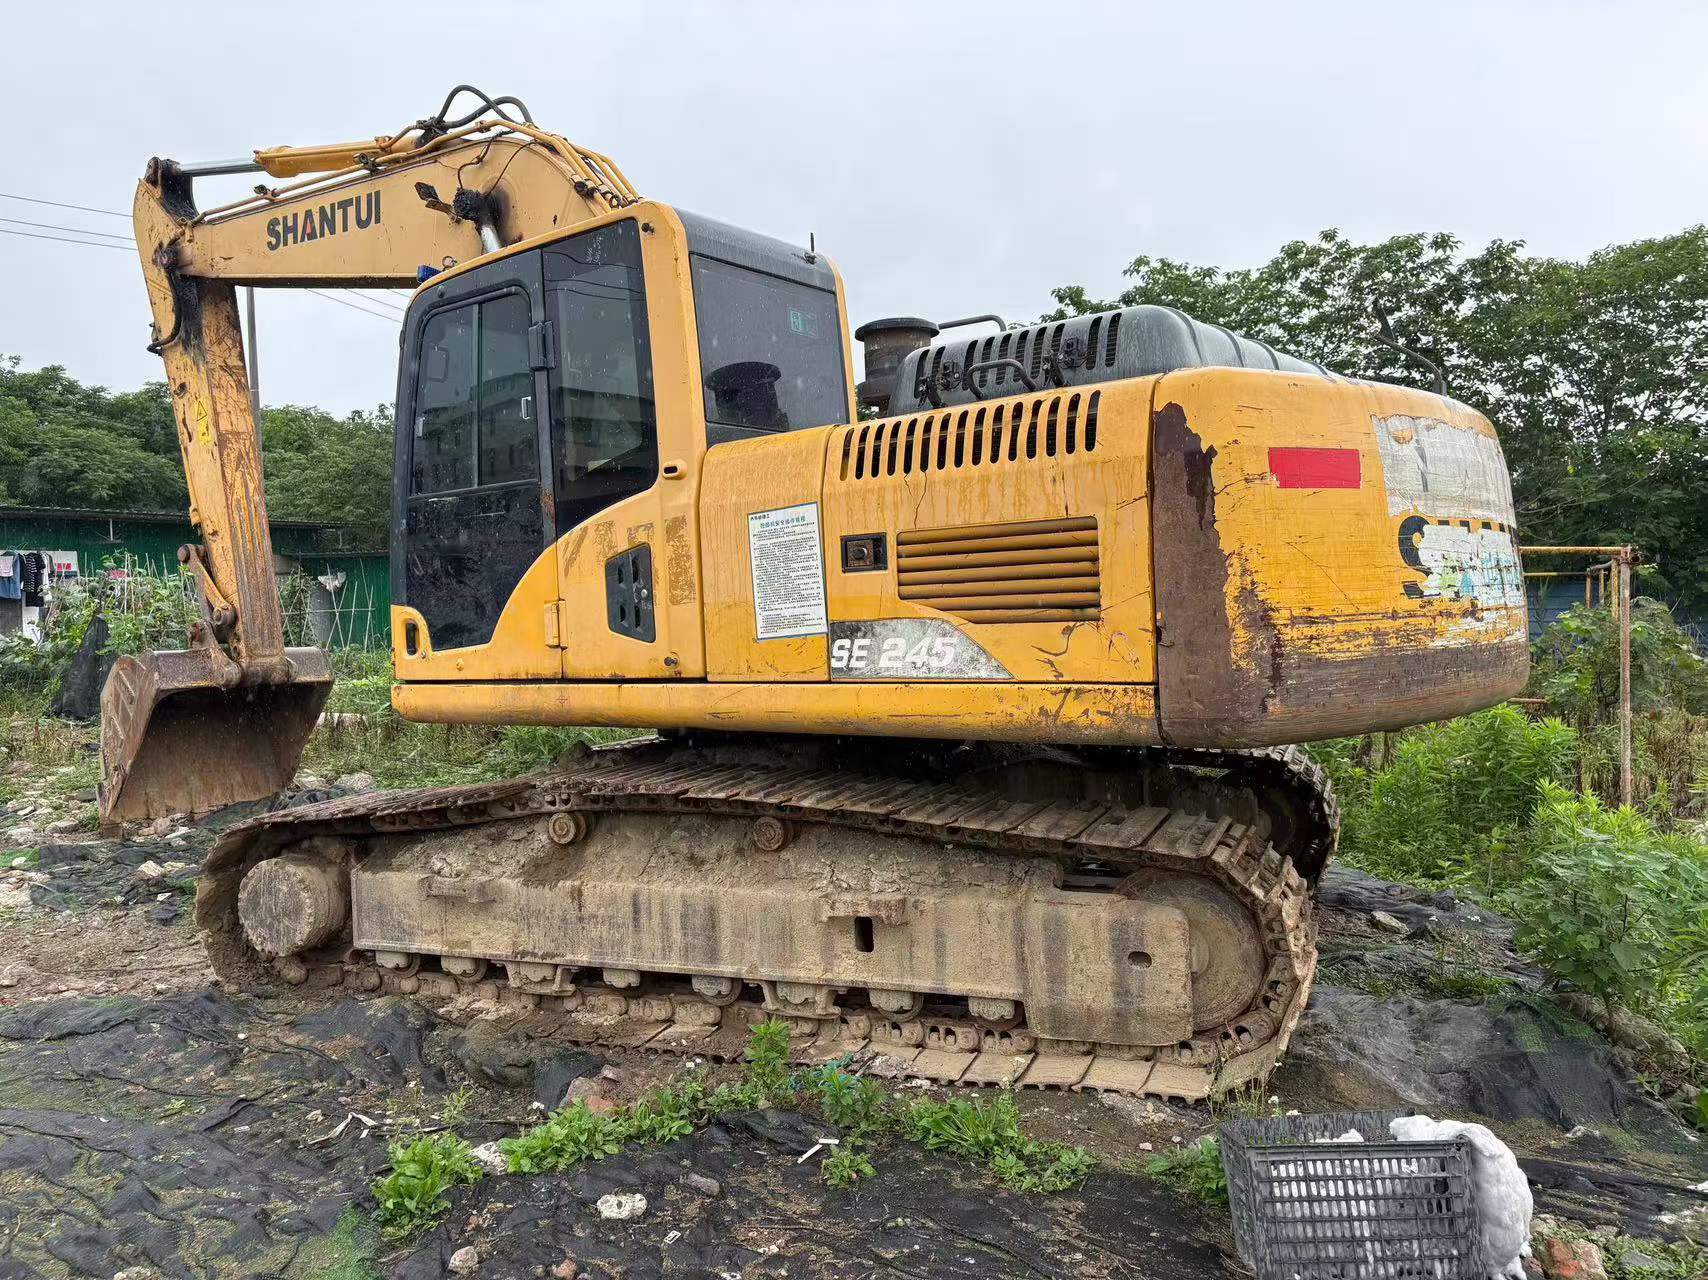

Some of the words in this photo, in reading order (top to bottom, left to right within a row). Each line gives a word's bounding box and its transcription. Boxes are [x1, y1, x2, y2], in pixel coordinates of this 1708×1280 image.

[267, 190, 381, 251] SHANTUI
[831, 638, 871, 668] SE
[879, 637, 958, 668] 245
